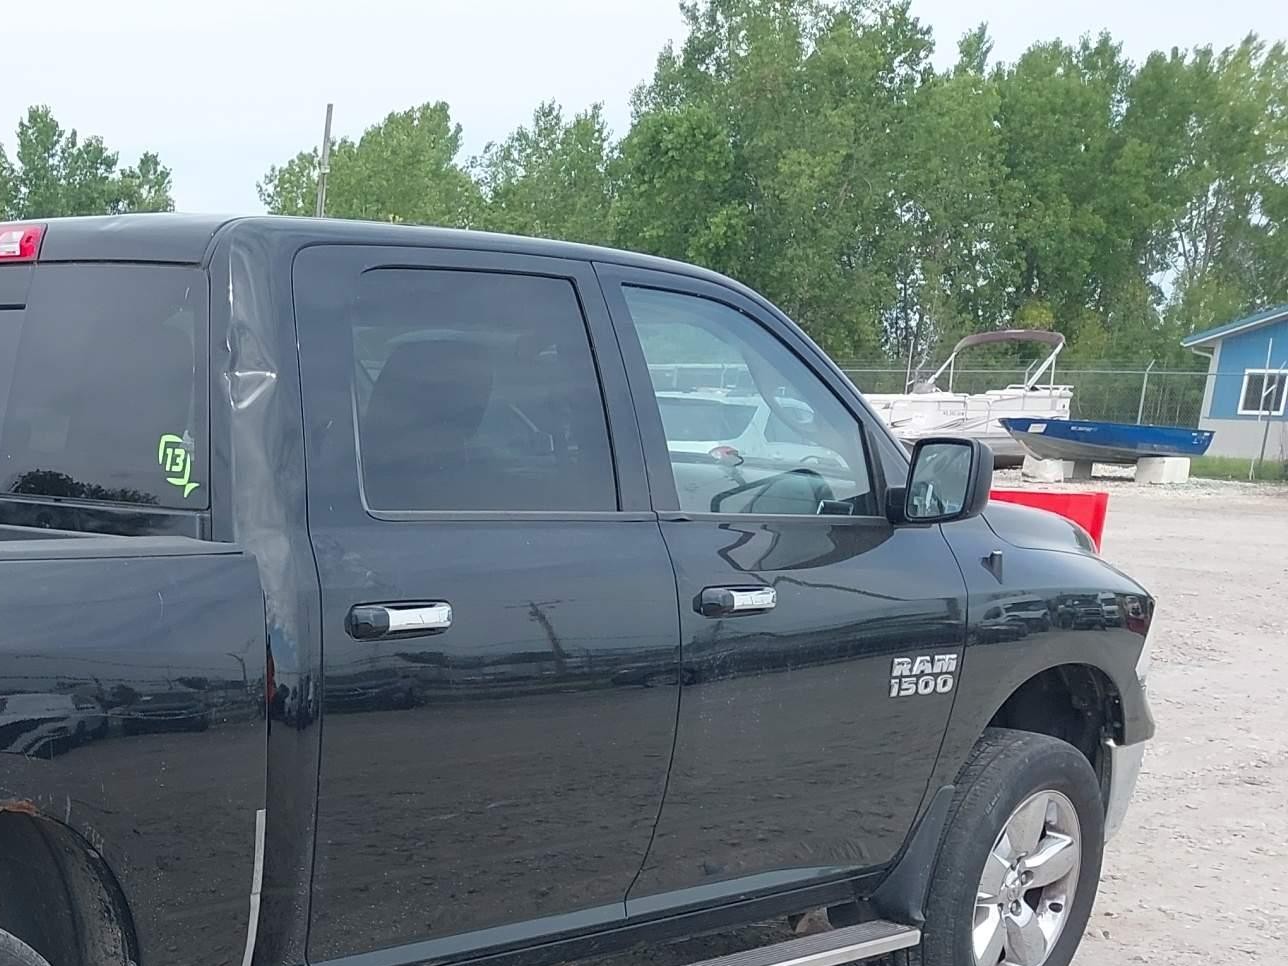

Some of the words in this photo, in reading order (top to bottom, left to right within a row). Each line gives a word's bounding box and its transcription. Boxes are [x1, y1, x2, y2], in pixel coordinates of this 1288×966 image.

[165, 447, 186, 472] 13
[892, 654, 958, 677] RAM
[890, 674, 954, 698] 1500
